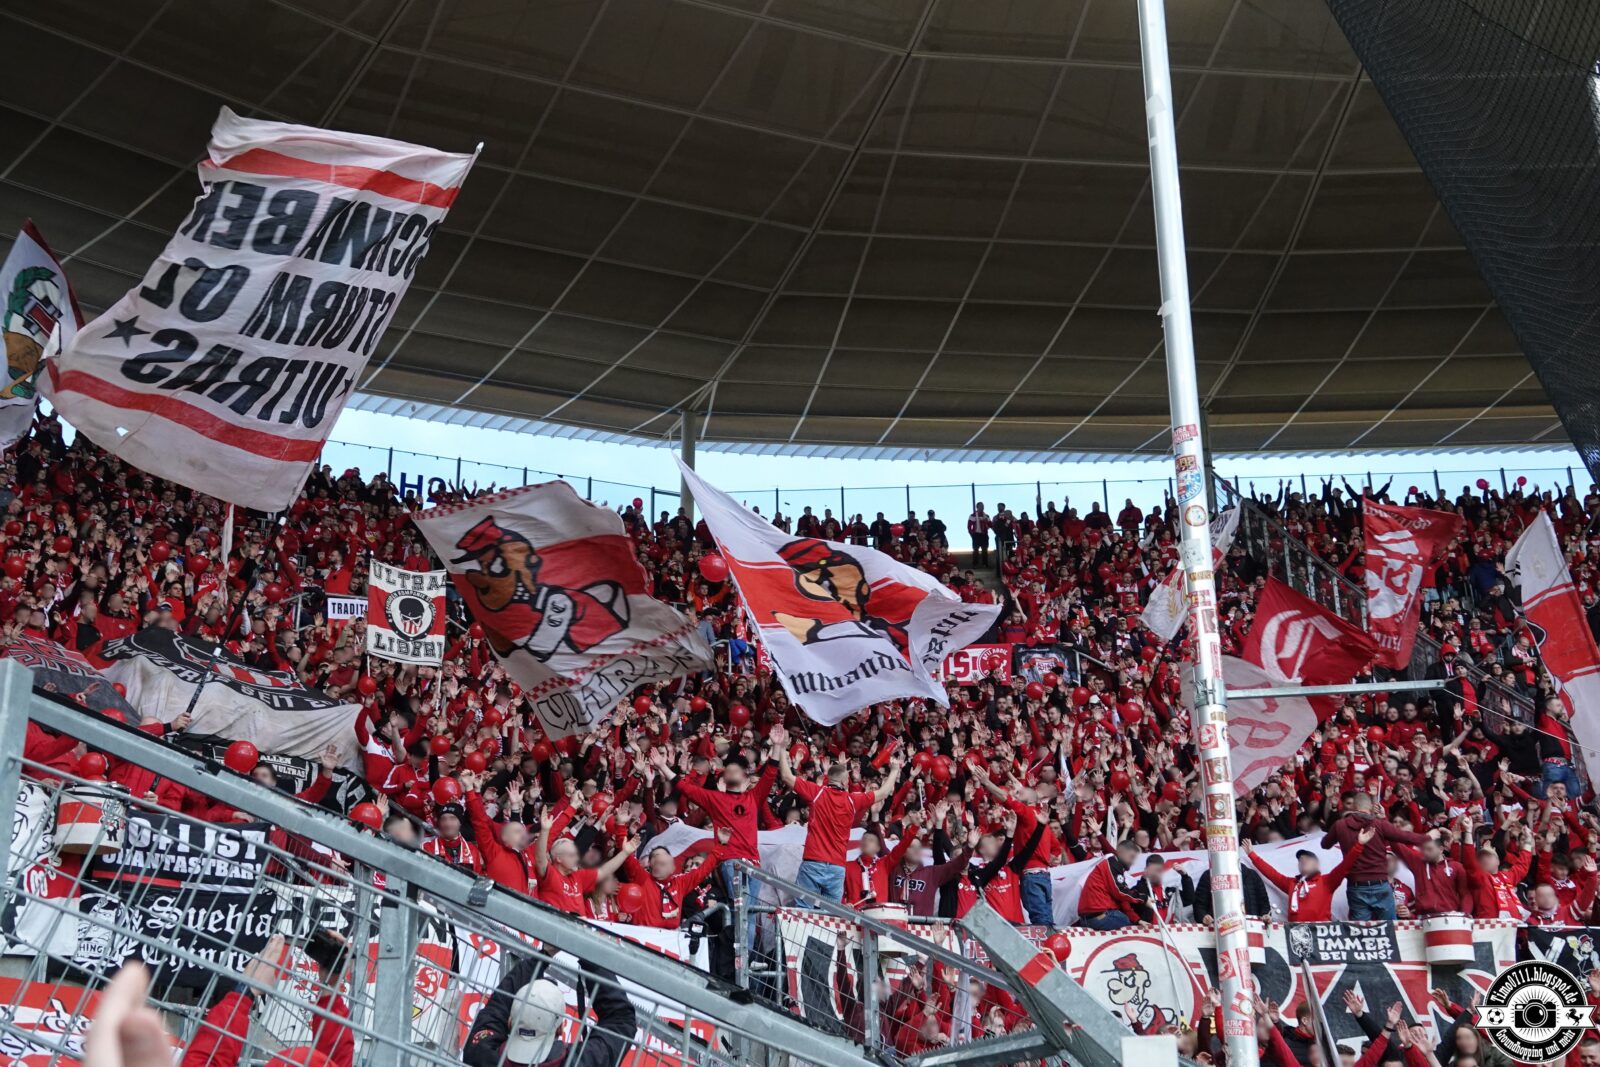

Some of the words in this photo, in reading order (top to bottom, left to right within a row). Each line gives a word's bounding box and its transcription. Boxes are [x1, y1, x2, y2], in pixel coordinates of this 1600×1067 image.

[242, 685, 296, 708] SEIT
[204, 825, 266, 860] IST
[146, 896, 273, 938] Suebia
[1315, 925, 1342, 936] DU
[1349, 923, 1387, 936] BIST
[1317, 937, 1392, 951] IMMER
[1319, 951, 1347, 960] BEI
[1353, 949, 1393, 960] UNS!
